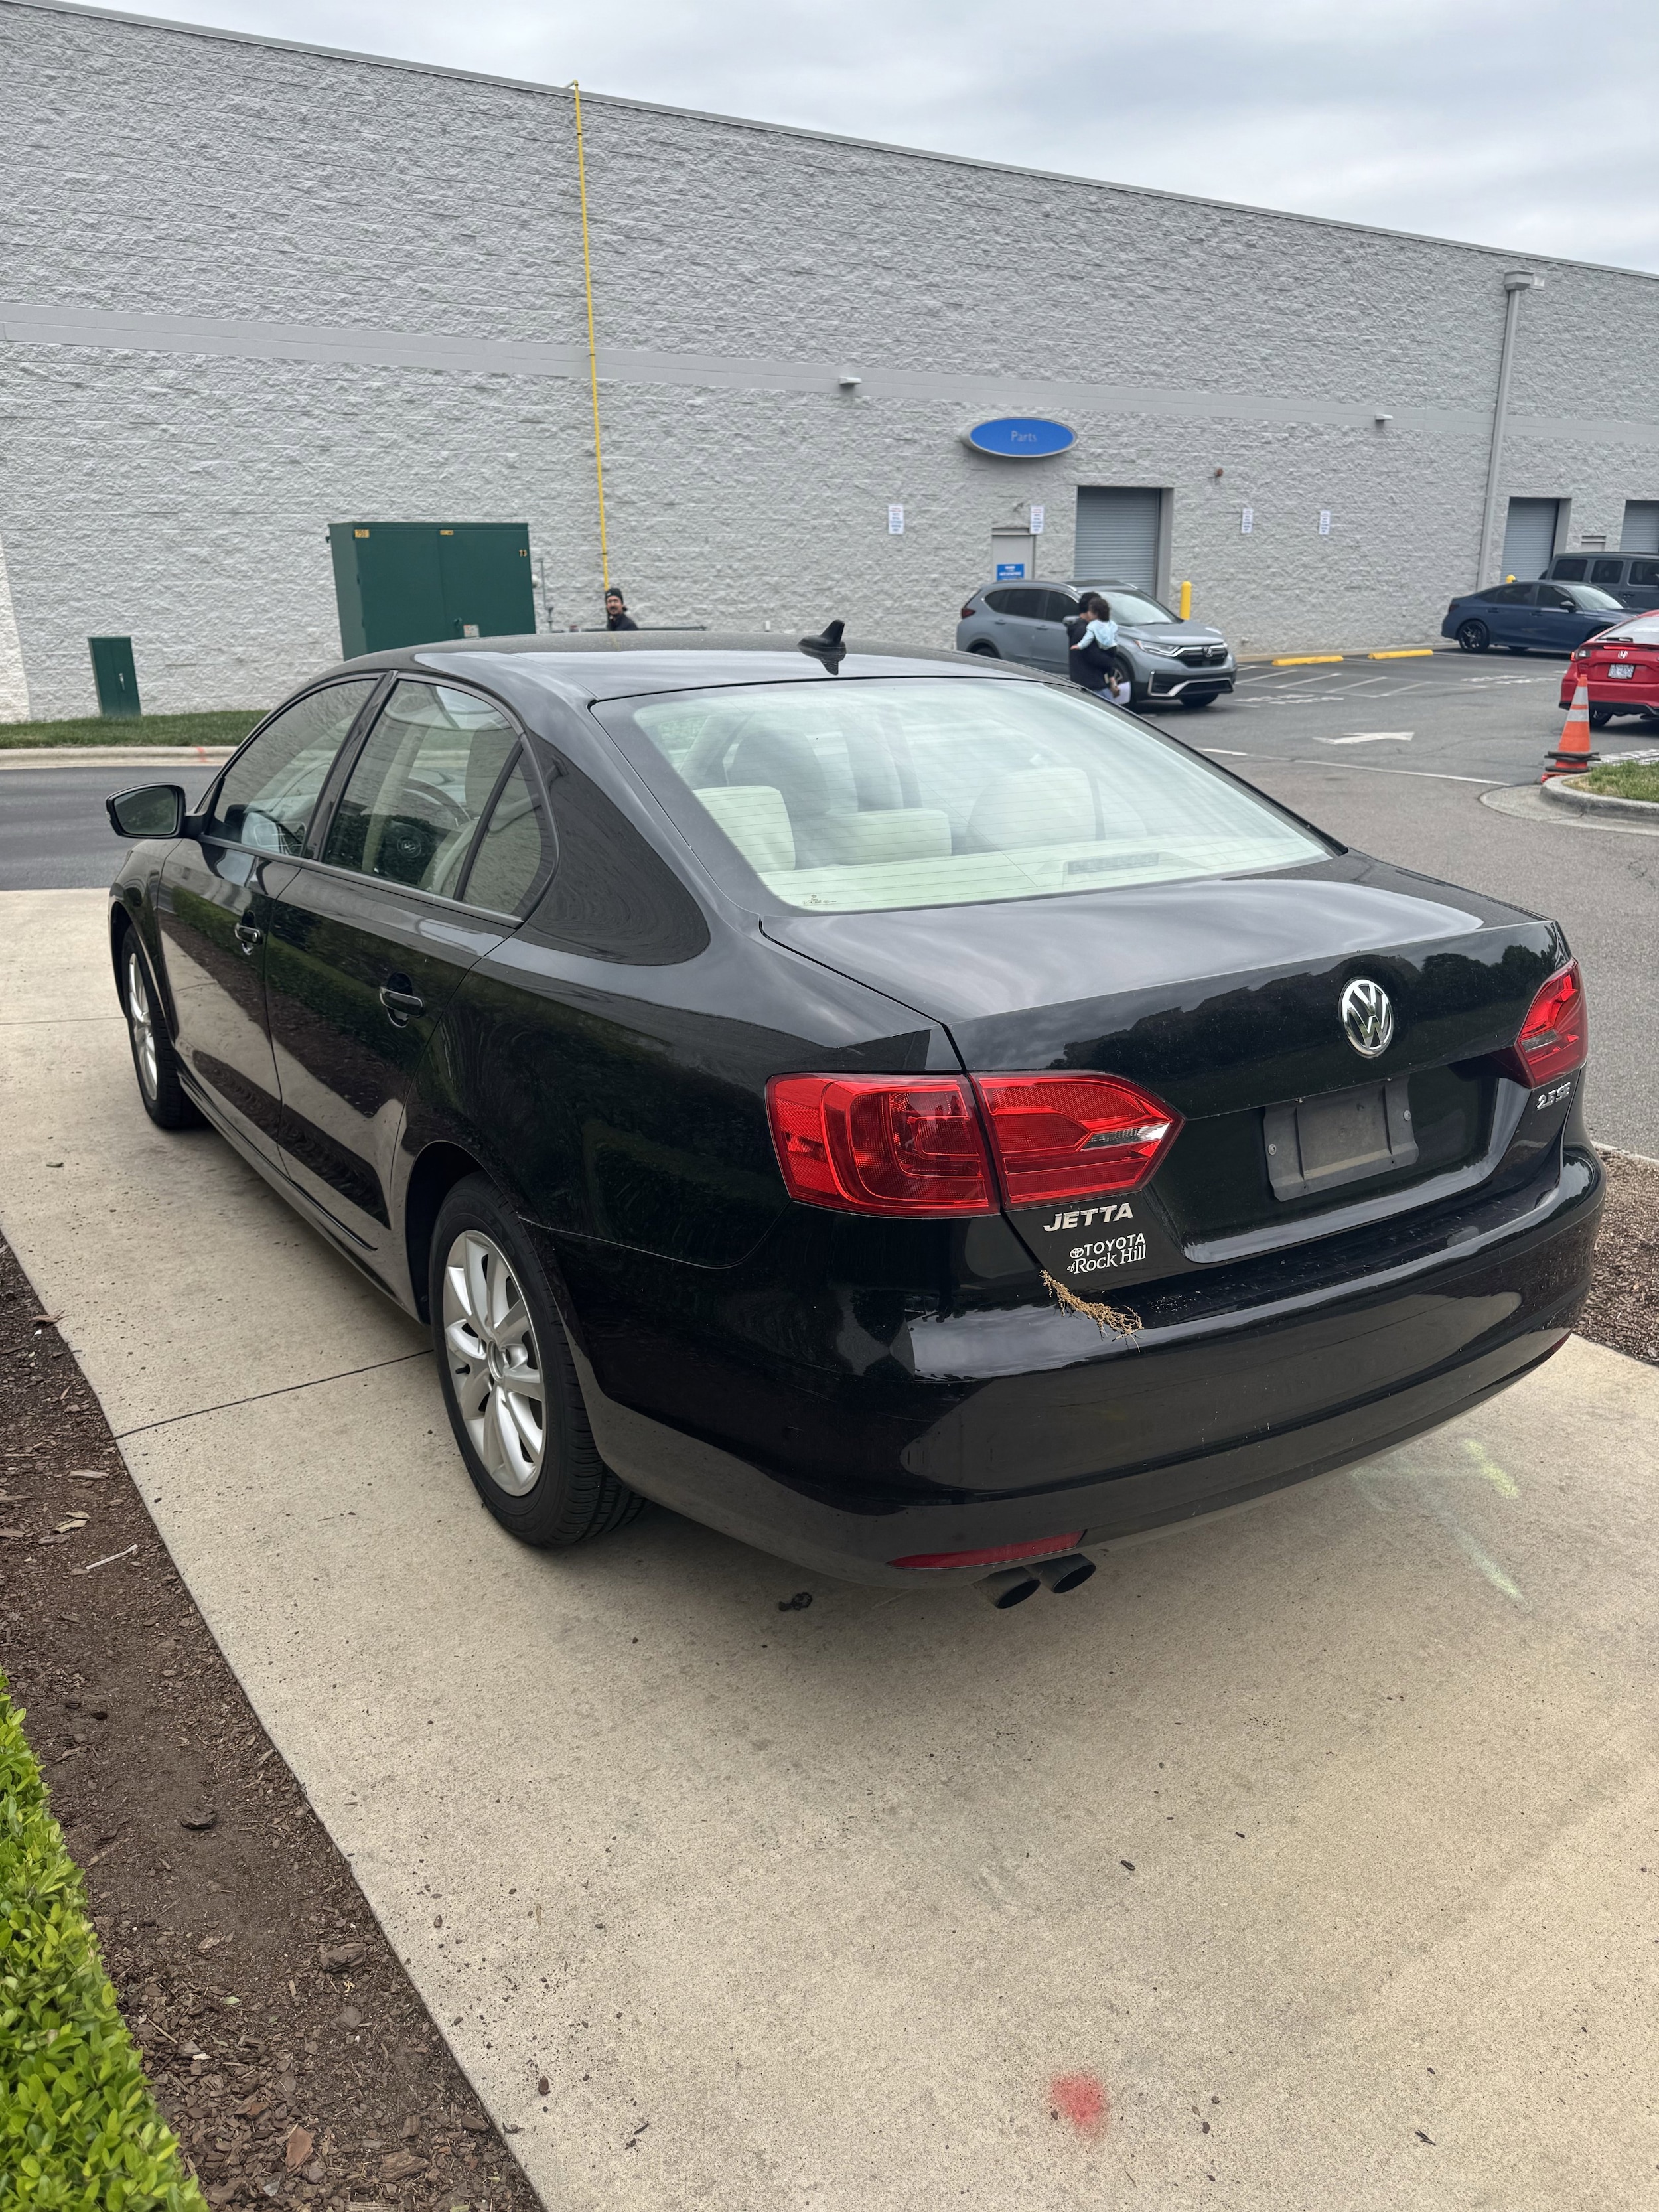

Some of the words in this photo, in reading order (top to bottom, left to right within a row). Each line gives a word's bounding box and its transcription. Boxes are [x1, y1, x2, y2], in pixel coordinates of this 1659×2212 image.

[1011, 430, 1037, 442] Parts
[1043, 1202, 1134, 1232] JETTA
[1084, 1232, 1146, 1256] TOYOTA
[1066, 1262, 1076, 1273] of
[1074, 1252, 1118, 1274] Rock
[1119, 1244, 1147, 1265] Hill
